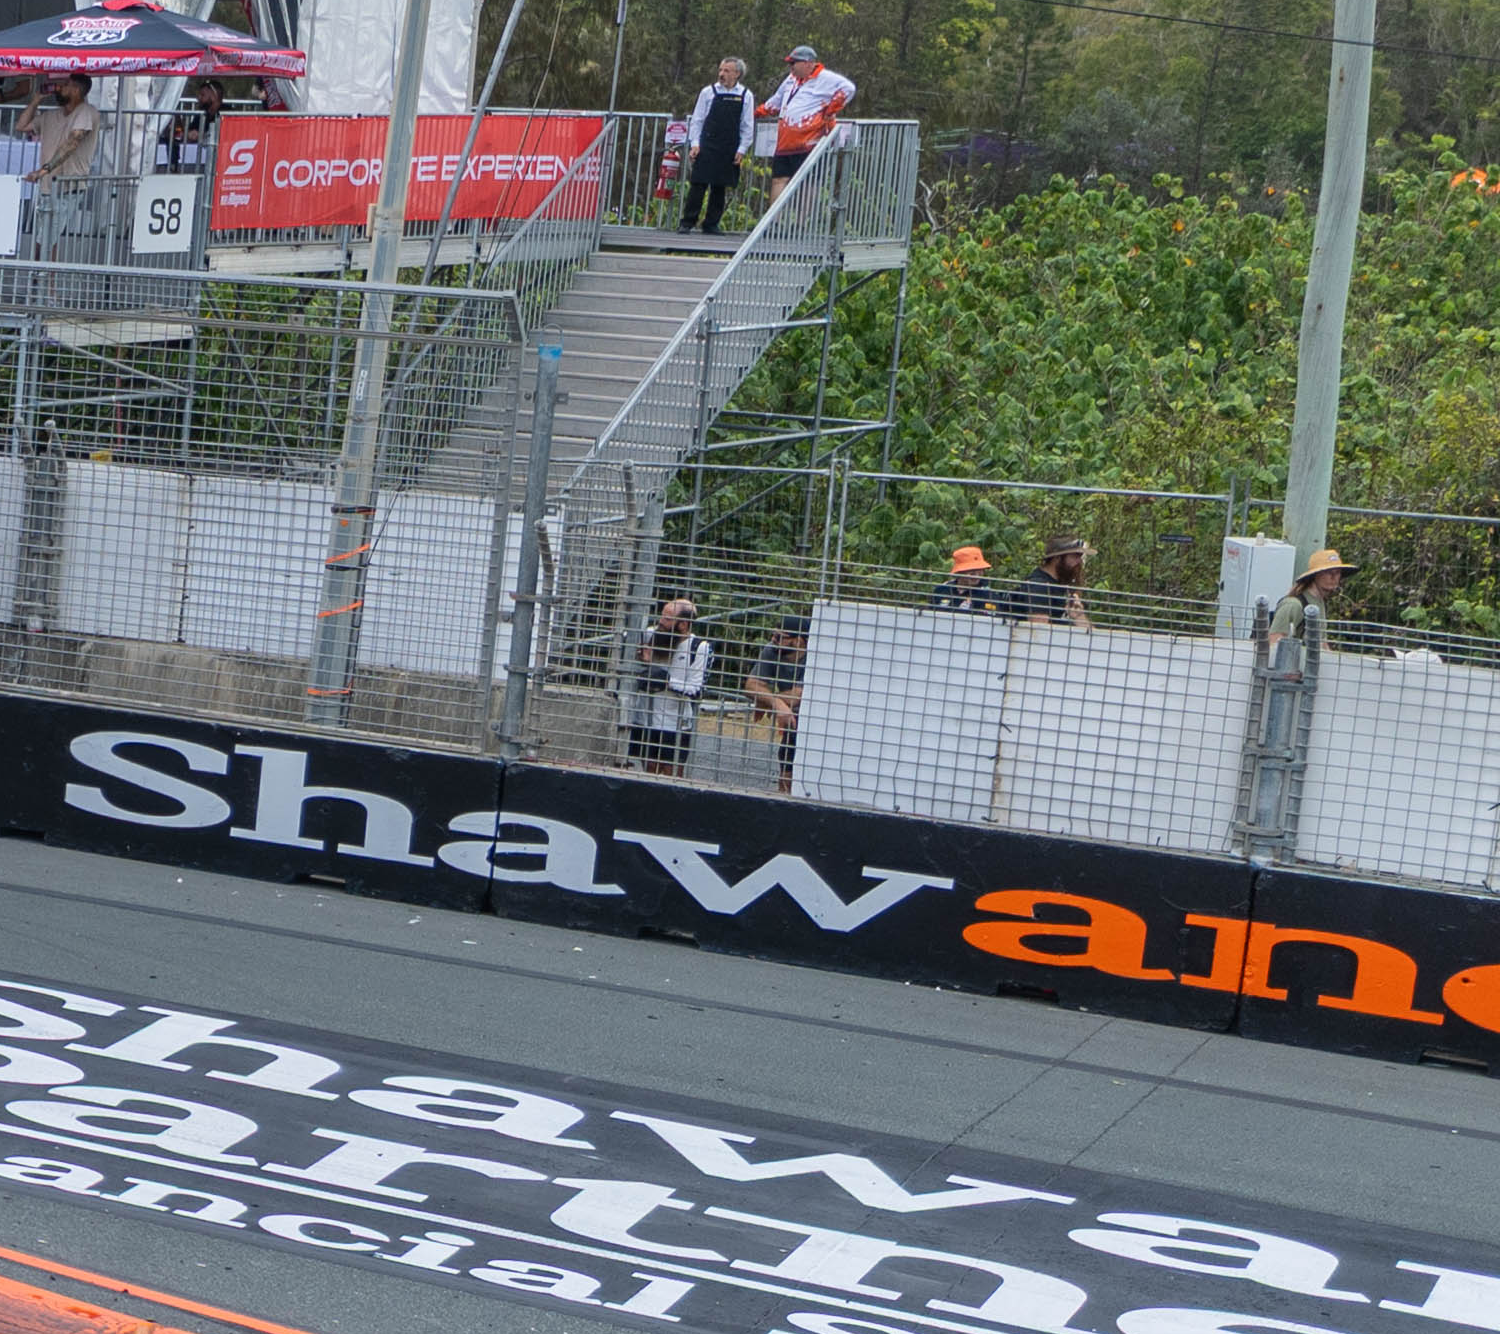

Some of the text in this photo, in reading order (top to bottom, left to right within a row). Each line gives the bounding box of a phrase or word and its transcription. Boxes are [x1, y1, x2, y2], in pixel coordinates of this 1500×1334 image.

[272, 155, 437, 188] CORPORTE
[149, 198, 182, 235] S8
[64, 731, 953, 931] Shaw
